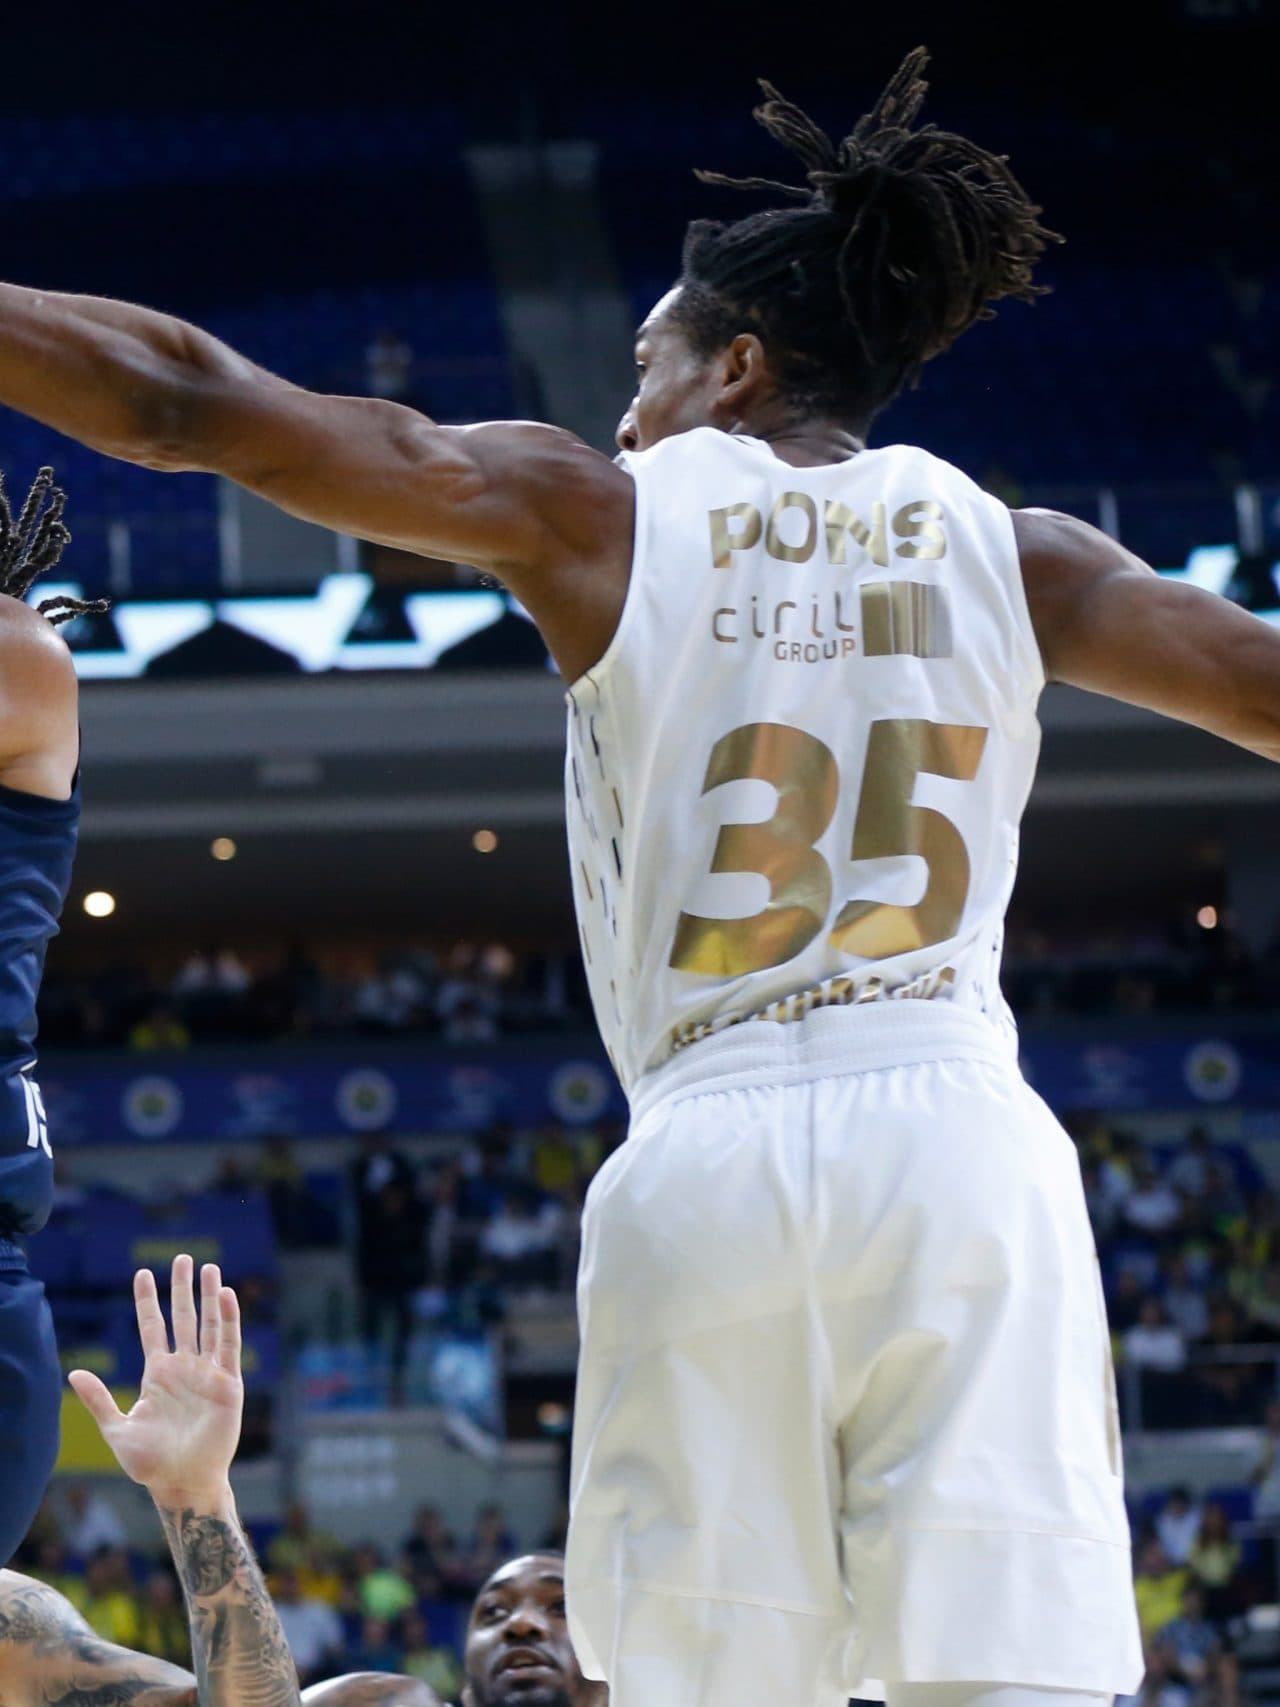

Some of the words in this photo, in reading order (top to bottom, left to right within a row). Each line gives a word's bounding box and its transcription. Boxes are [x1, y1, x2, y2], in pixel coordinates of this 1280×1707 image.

[708, 490, 947, 568] PONS
[711, 590, 855, 643] ciril
[773, 637, 857, 664] GROUP
[668, 718, 989, 977] 35
